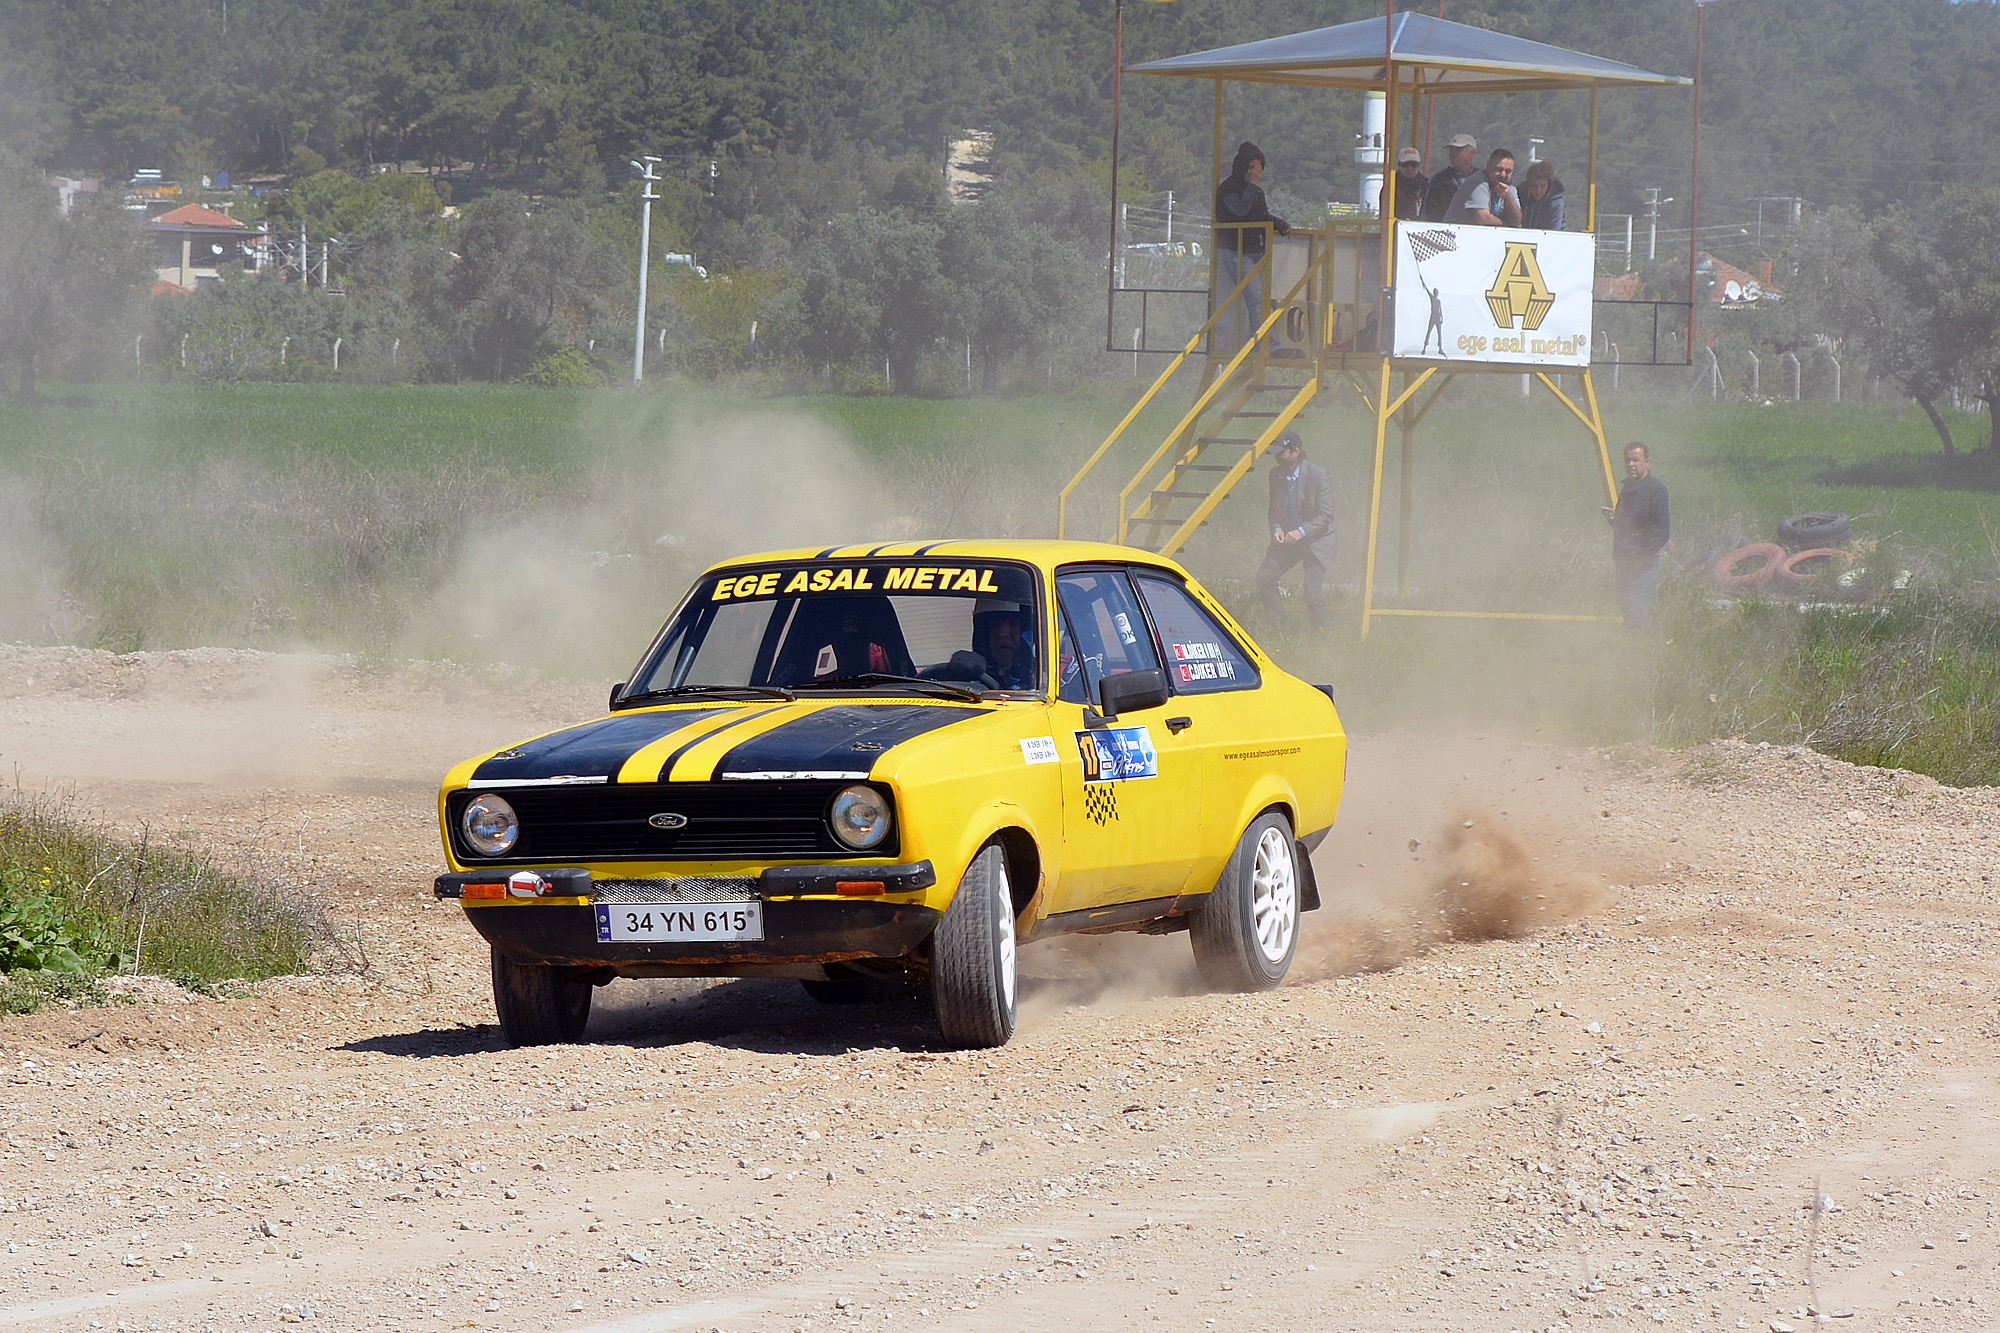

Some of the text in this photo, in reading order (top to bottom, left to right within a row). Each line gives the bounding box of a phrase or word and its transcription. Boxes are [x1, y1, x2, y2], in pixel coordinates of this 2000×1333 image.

[1457, 334, 1488, 355] ege
[1492, 331, 1526, 353] asal
[711, 567, 999, 602] EGE ASAL METAL
[1223, 746, 1302, 761] www.egeasalmotorspor.com
[657, 815, 678, 826] Ford
[600, 926, 610, 934] TR
[626, 911, 747, 933] 34 YN 615
